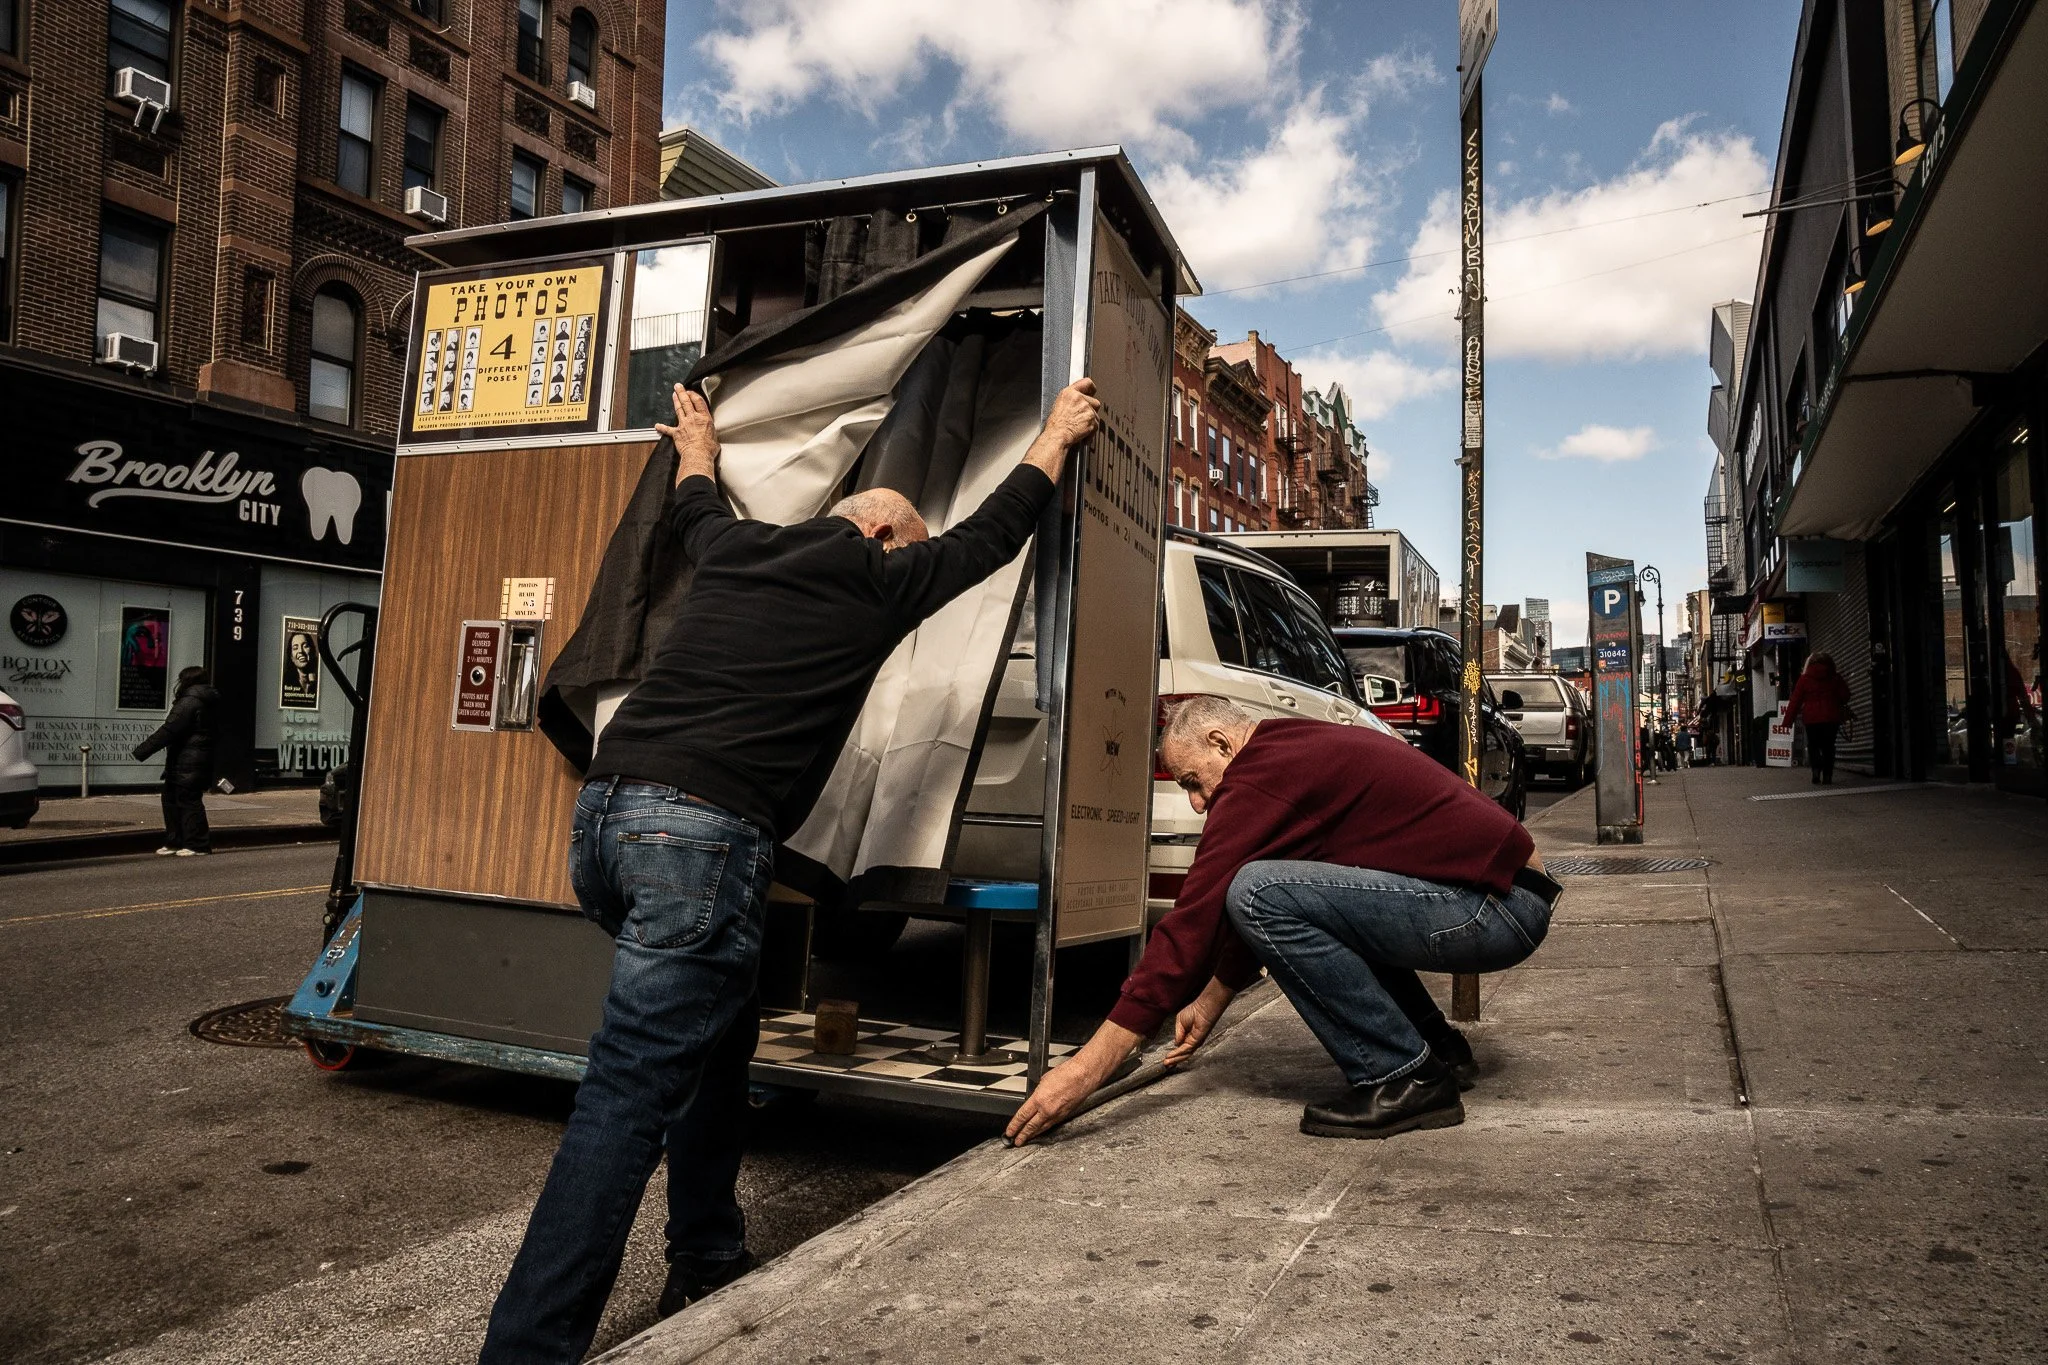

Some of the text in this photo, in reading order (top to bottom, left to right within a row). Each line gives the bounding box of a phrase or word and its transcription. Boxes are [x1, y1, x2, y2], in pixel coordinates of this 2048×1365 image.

[451, 275, 578, 296] TAKE YOUR OWN
[454, 288, 569, 323] PHOTOS
[1097, 271, 1165, 382] TAKE YOUR OWN
[489, 333, 516, 360] 4
[478, 365, 529, 375] DIFFERENT
[1103, 402, 1151, 460] MINIATURE
[64, 440, 277, 508] Brooklyn
[1086, 419, 1159, 540] PORTRAITS
[239, 500, 281, 526] CITY
[1084, 499, 1109, 527] PHOTOS
[1113, 521, 1120, 535] IN
[1134, 540, 1156, 565] MINUTES
[1364, 580, 1375, 591] 4
[1604, 589, 1621, 614] P
[1768, 625, 1801, 635] FedEx
[3, 656, 71, 672] BOTOX
[476, 656, 493, 664] MINUTES
[9, 667, 66, 684] Special
[282, 709, 319, 724] New
[35, 721, 77, 730] RUSSIAN
[112, 723, 131, 732] FOX
[132, 724, 156, 732] EYES
[1772, 725, 1791, 735] SELL
[31, 732, 49, 740] HIN
[53, 732, 61, 740] &
[63, 732, 82, 741] JAW
[1105, 740, 1120, 756] NEW
[1768, 748, 1790, 757] BOXES
[48, 753, 59, 761] RF
[278, 744, 350, 771] WELCO
[1071, 804, 1103, 821] ELECTRONIC
